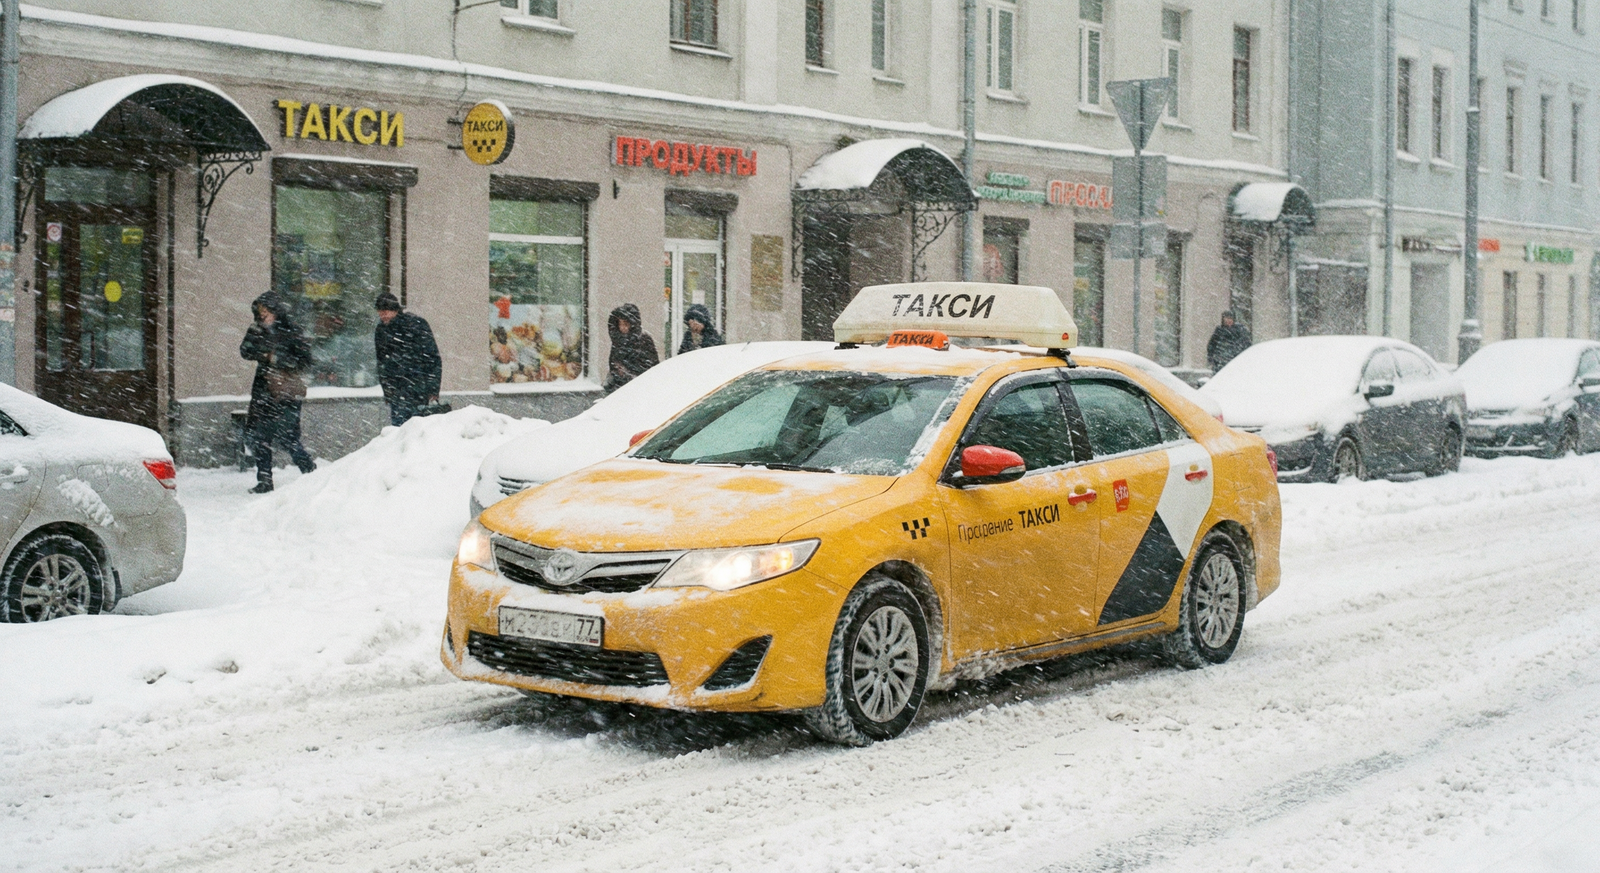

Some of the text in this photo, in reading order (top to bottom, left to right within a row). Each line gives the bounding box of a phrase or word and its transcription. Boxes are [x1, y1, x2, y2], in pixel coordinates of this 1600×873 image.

[278, 100, 404, 147] ТАКСИ
[467, 120, 503, 133] ТАКСИ
[616, 136, 757, 177] ПРОДУКТЫ
[892, 293, 996, 319] ТАКСИ
[1018, 504, 1060, 529] ТАКСИ
[577, 618, 595, 636] 77
